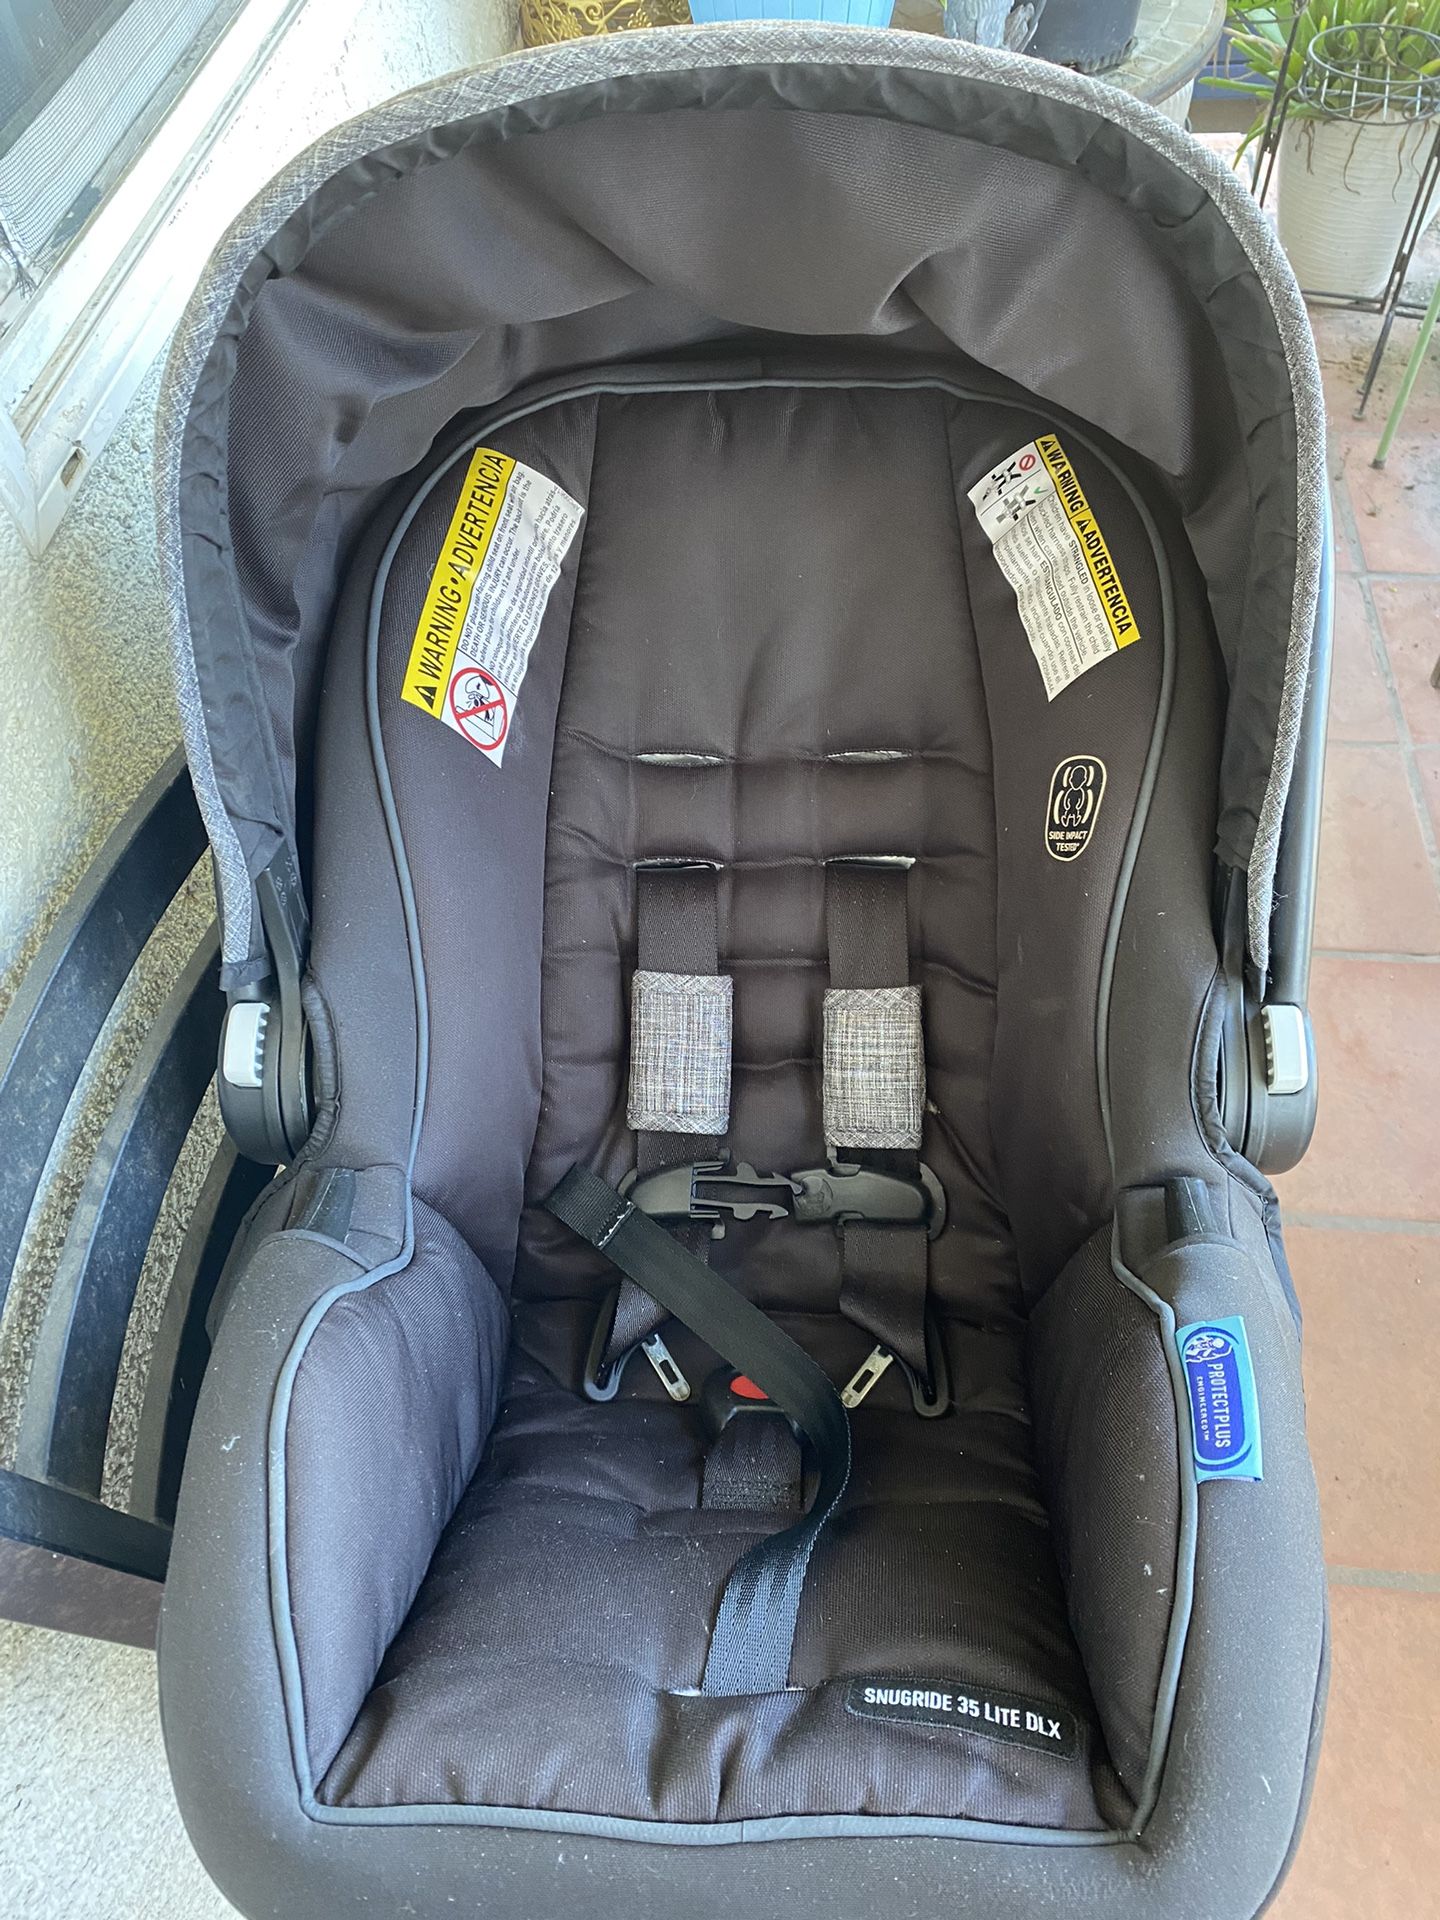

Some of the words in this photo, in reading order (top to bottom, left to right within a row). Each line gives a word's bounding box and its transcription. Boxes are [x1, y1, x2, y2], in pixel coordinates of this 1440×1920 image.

[416, 583, 462, 681] WARNING
[447, 452, 508, 581] ADVERTENCIA
[1046, 447, 1086, 513] WARNING
[1081, 530, 1133, 636] ADVERTENCIA
[1067, 539, 1089, 585] STRANGLED
[469, 632, 481, 657] DEATH
[476, 619, 485, 634] OR
[487, 567, 502, 594] INJURY
[488, 586, 506, 616] children
[503, 565, 513, 581] and
[460, 637, 469, 651] DO
[463, 622, 474, 640] NOT
[1049, 831, 1065, 840] SIDE
[1207, 1362, 1231, 1448] PROTECTPLUS
[864, 1687, 953, 1712] SNUGRIDE
[957, 1695, 980, 1718] 35
[984, 1702, 1021, 1728] LITE
[1026, 1711, 1062, 1740] DLX
